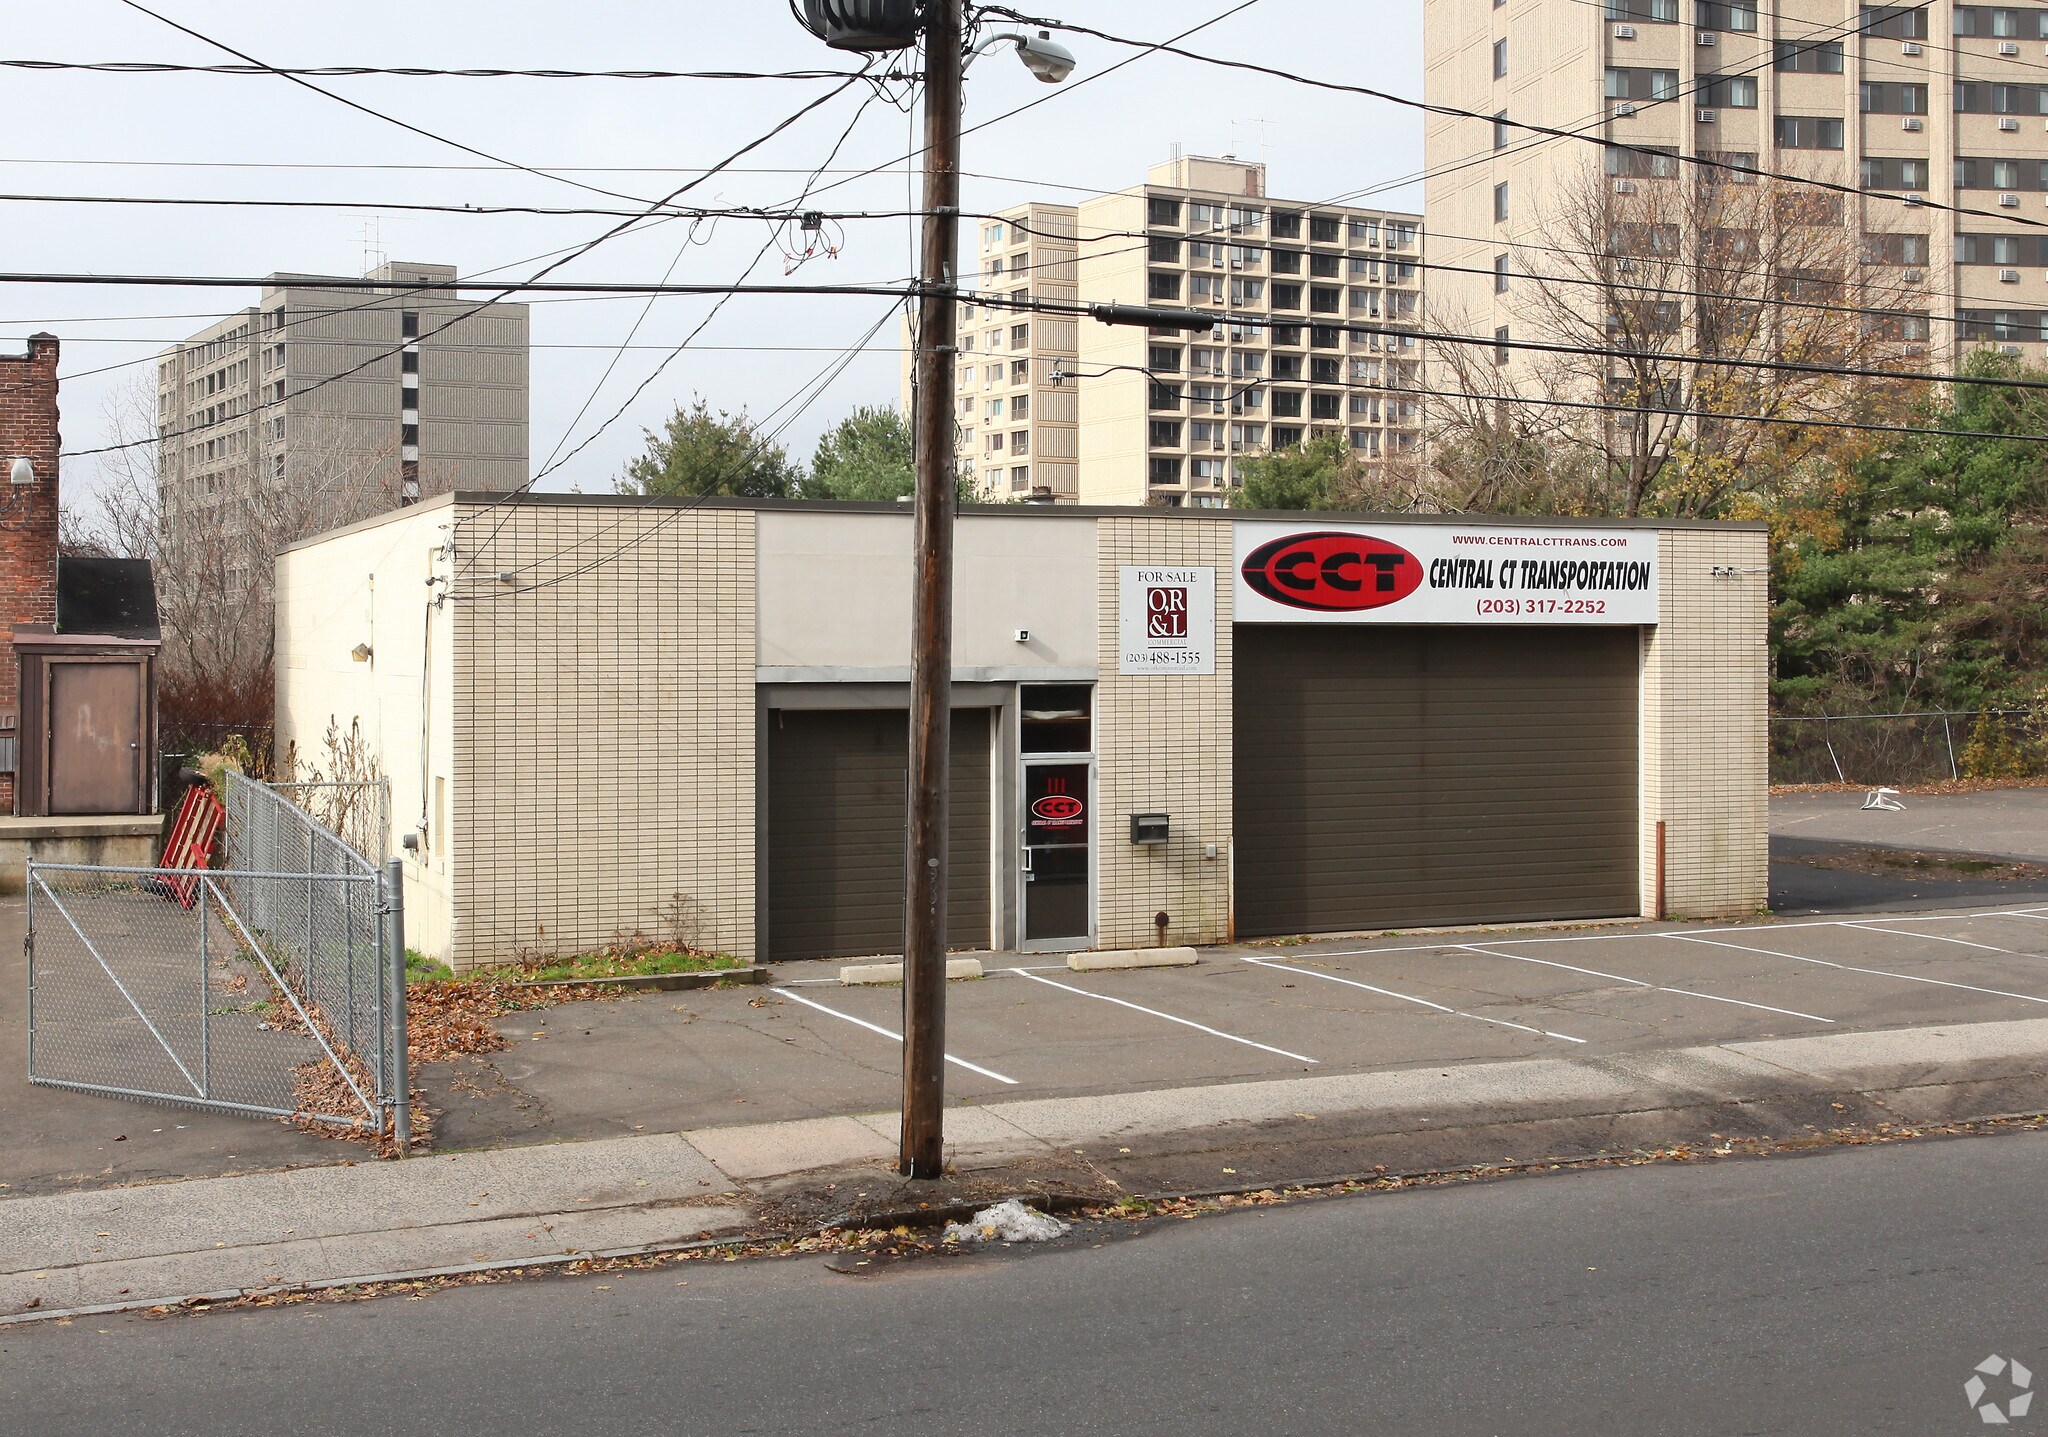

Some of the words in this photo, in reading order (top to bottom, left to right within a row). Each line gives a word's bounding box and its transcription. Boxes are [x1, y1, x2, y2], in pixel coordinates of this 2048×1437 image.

[1452, 535, 1628, 547] WWW.CENTRALCTTRANS.COM
[1138, 571, 1163, 582] FOR
[1166, 571, 1197, 583] SALE
[1273, 551, 1405, 592] CCT
[1429, 557, 1494, 589] CENTRAL
[1499, 558, 1517, 589] CT
[1521, 560, 1650, 591] TRANSPORTATION
[1476, 598, 1520, 615] (203)
[1525, 599, 1606, 614] 317-2252
[1126, 653, 1148, 663] (203)
[1150, 651, 1200, 664] 488-1555
[1042, 802, 1076, 812] CCT
